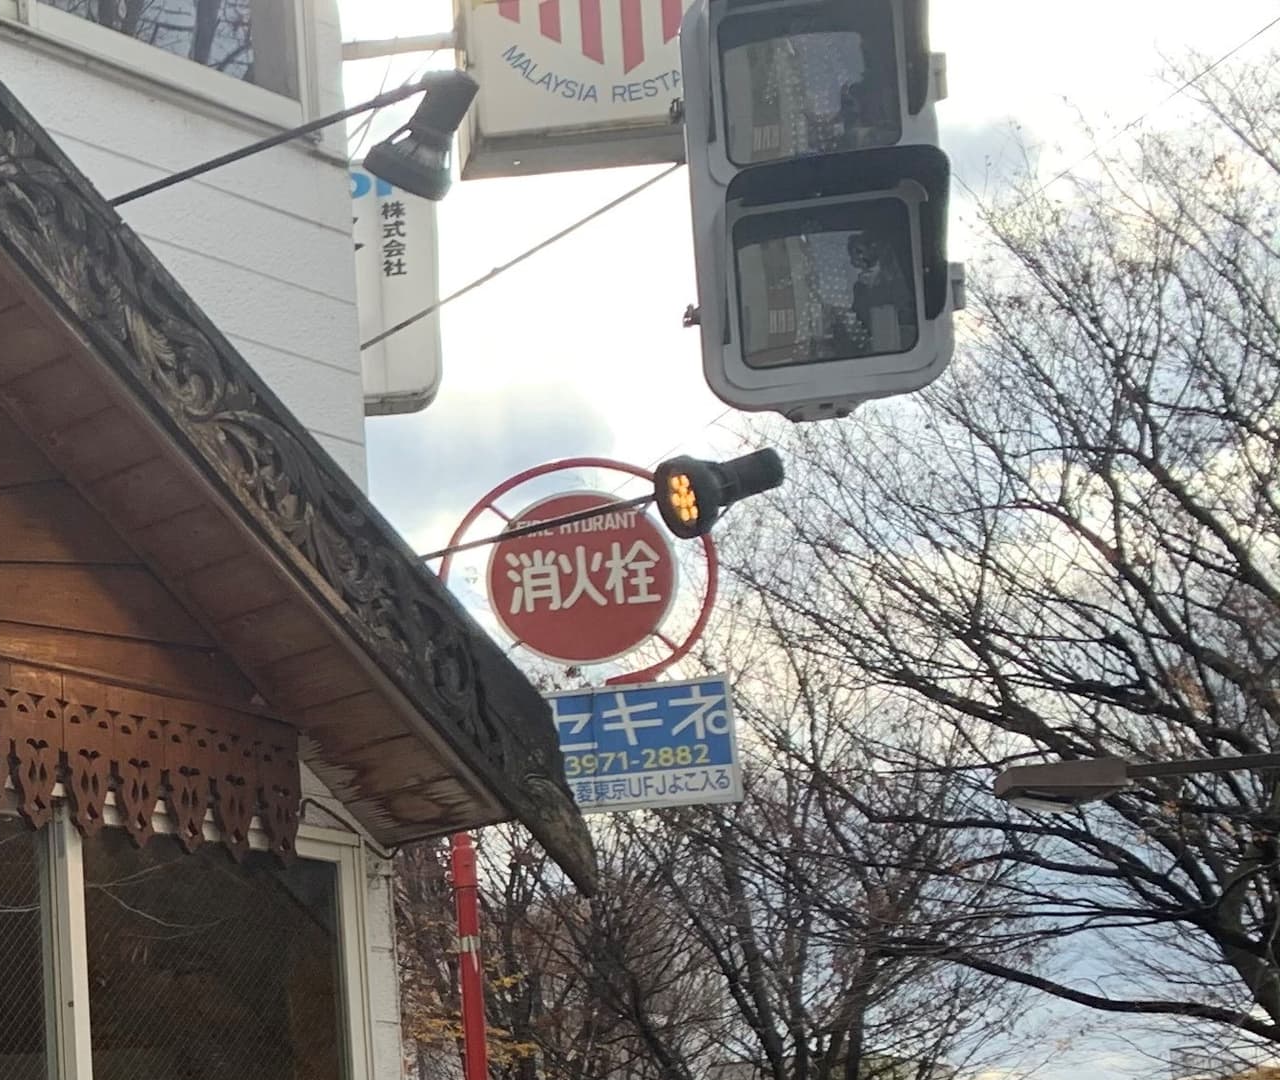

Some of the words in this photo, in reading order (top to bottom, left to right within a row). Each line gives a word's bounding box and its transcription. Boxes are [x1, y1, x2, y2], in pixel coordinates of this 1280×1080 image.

[501, 44, 599, 103] MALAYSIA
[381, 200, 408, 277] 株式会社
[504, 539, 661, 615] 消火栓
